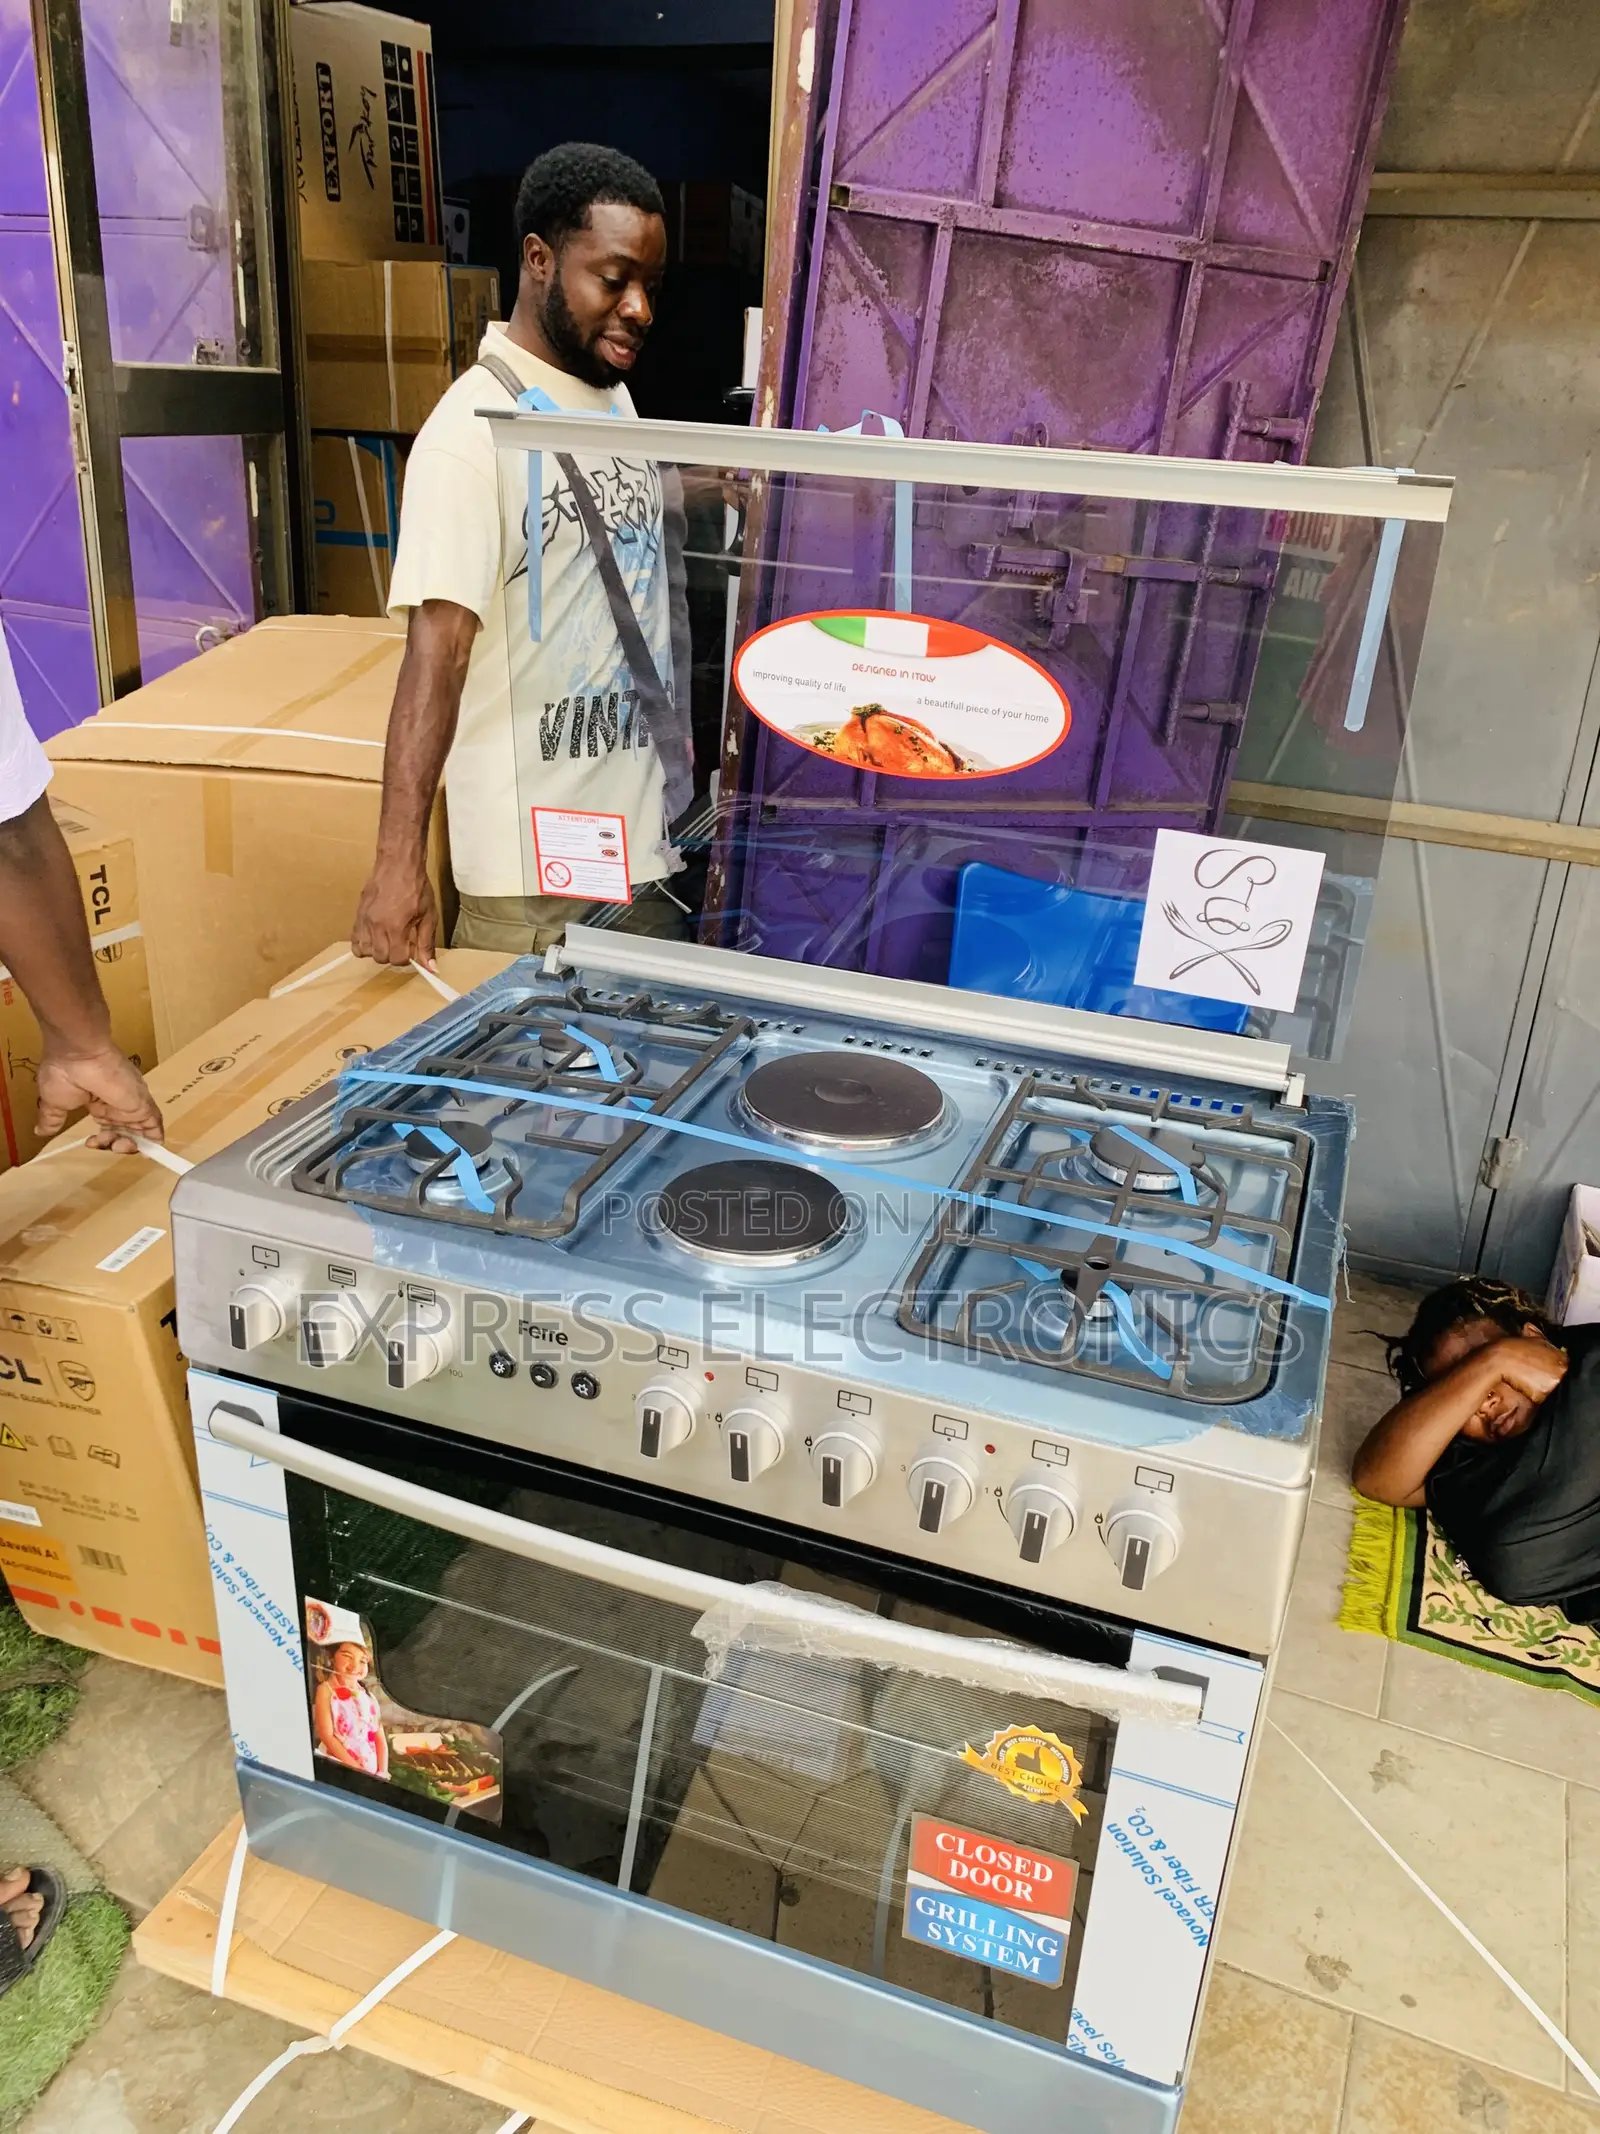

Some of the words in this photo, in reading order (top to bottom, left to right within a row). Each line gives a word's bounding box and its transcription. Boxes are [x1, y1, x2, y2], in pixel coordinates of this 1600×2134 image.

[317, 66, 340, 197] EXPORT
[752, 669, 793, 685] improving
[795, 676, 821, 690] quality
[823, 681, 832, 690] of
[834, 682, 847, 693] life
[852, 663, 897, 677] DESIGNED
[899, 669, 909, 679] IN
[924, 696, 964, 710] beautifull
[965, 704, 989, 714] piece
[991, 707, 1001, 716] of
[1002, 709, 1022, 719] your
[1024, 712, 1049, 723] home
[89, 864, 111, 926] TCL
[518, 1319, 569, 1346] Ferre
[222, 1551, 235, 1563] &
[234, 1566, 266, 1599] Fiber
[236, 1595, 287, 1647] Novacel
[263, 1600, 301, 1645] ASER
[990, 1762, 1018, 1776] BEST
[1019, 1772, 1061, 1792] CHOICE
[935, 1832, 1053, 1882] CLOSED
[1106, 1823, 1163, 1887] Solution
[1148, 1838, 1167, 1852] &
[947, 1858, 1034, 1902] DOOR
[1161, 1855, 1201, 1894] Fiber
[915, 1896, 1059, 1957] GRILLING
[1153, 1887, 1209, 1947] Novacel
[926, 1921, 1042, 1976] SYSTEM
[1072, 2007, 1105, 2040] acel
